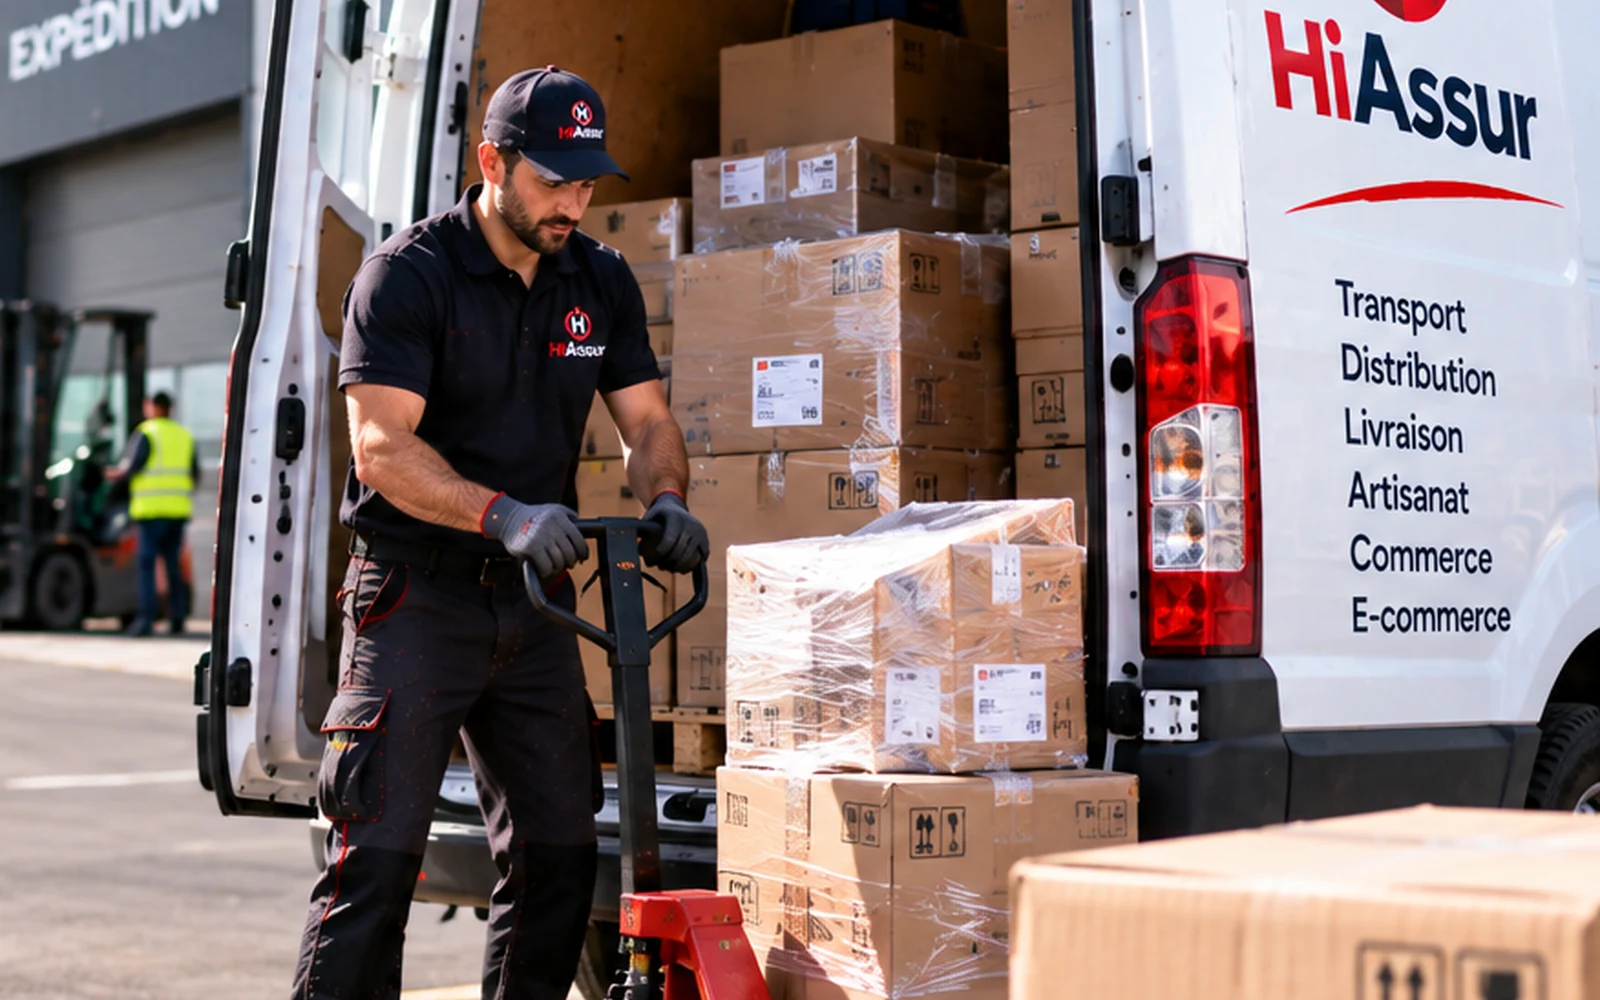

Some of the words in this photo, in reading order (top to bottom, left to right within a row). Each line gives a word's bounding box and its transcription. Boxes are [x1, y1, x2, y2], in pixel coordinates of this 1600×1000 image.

[1264, 10, 1537, 160] HiAssur
[1335, 279, 1467, 336] Transport
[1341, 343, 1496, 396] Distribution
[1345, 408, 1463, 453] Livraison
[1348, 471, 1469, 514] Artisanat
[1350, 534, 1492, 574] Commerce
[1352, 596, 1511, 633] E-commerce
